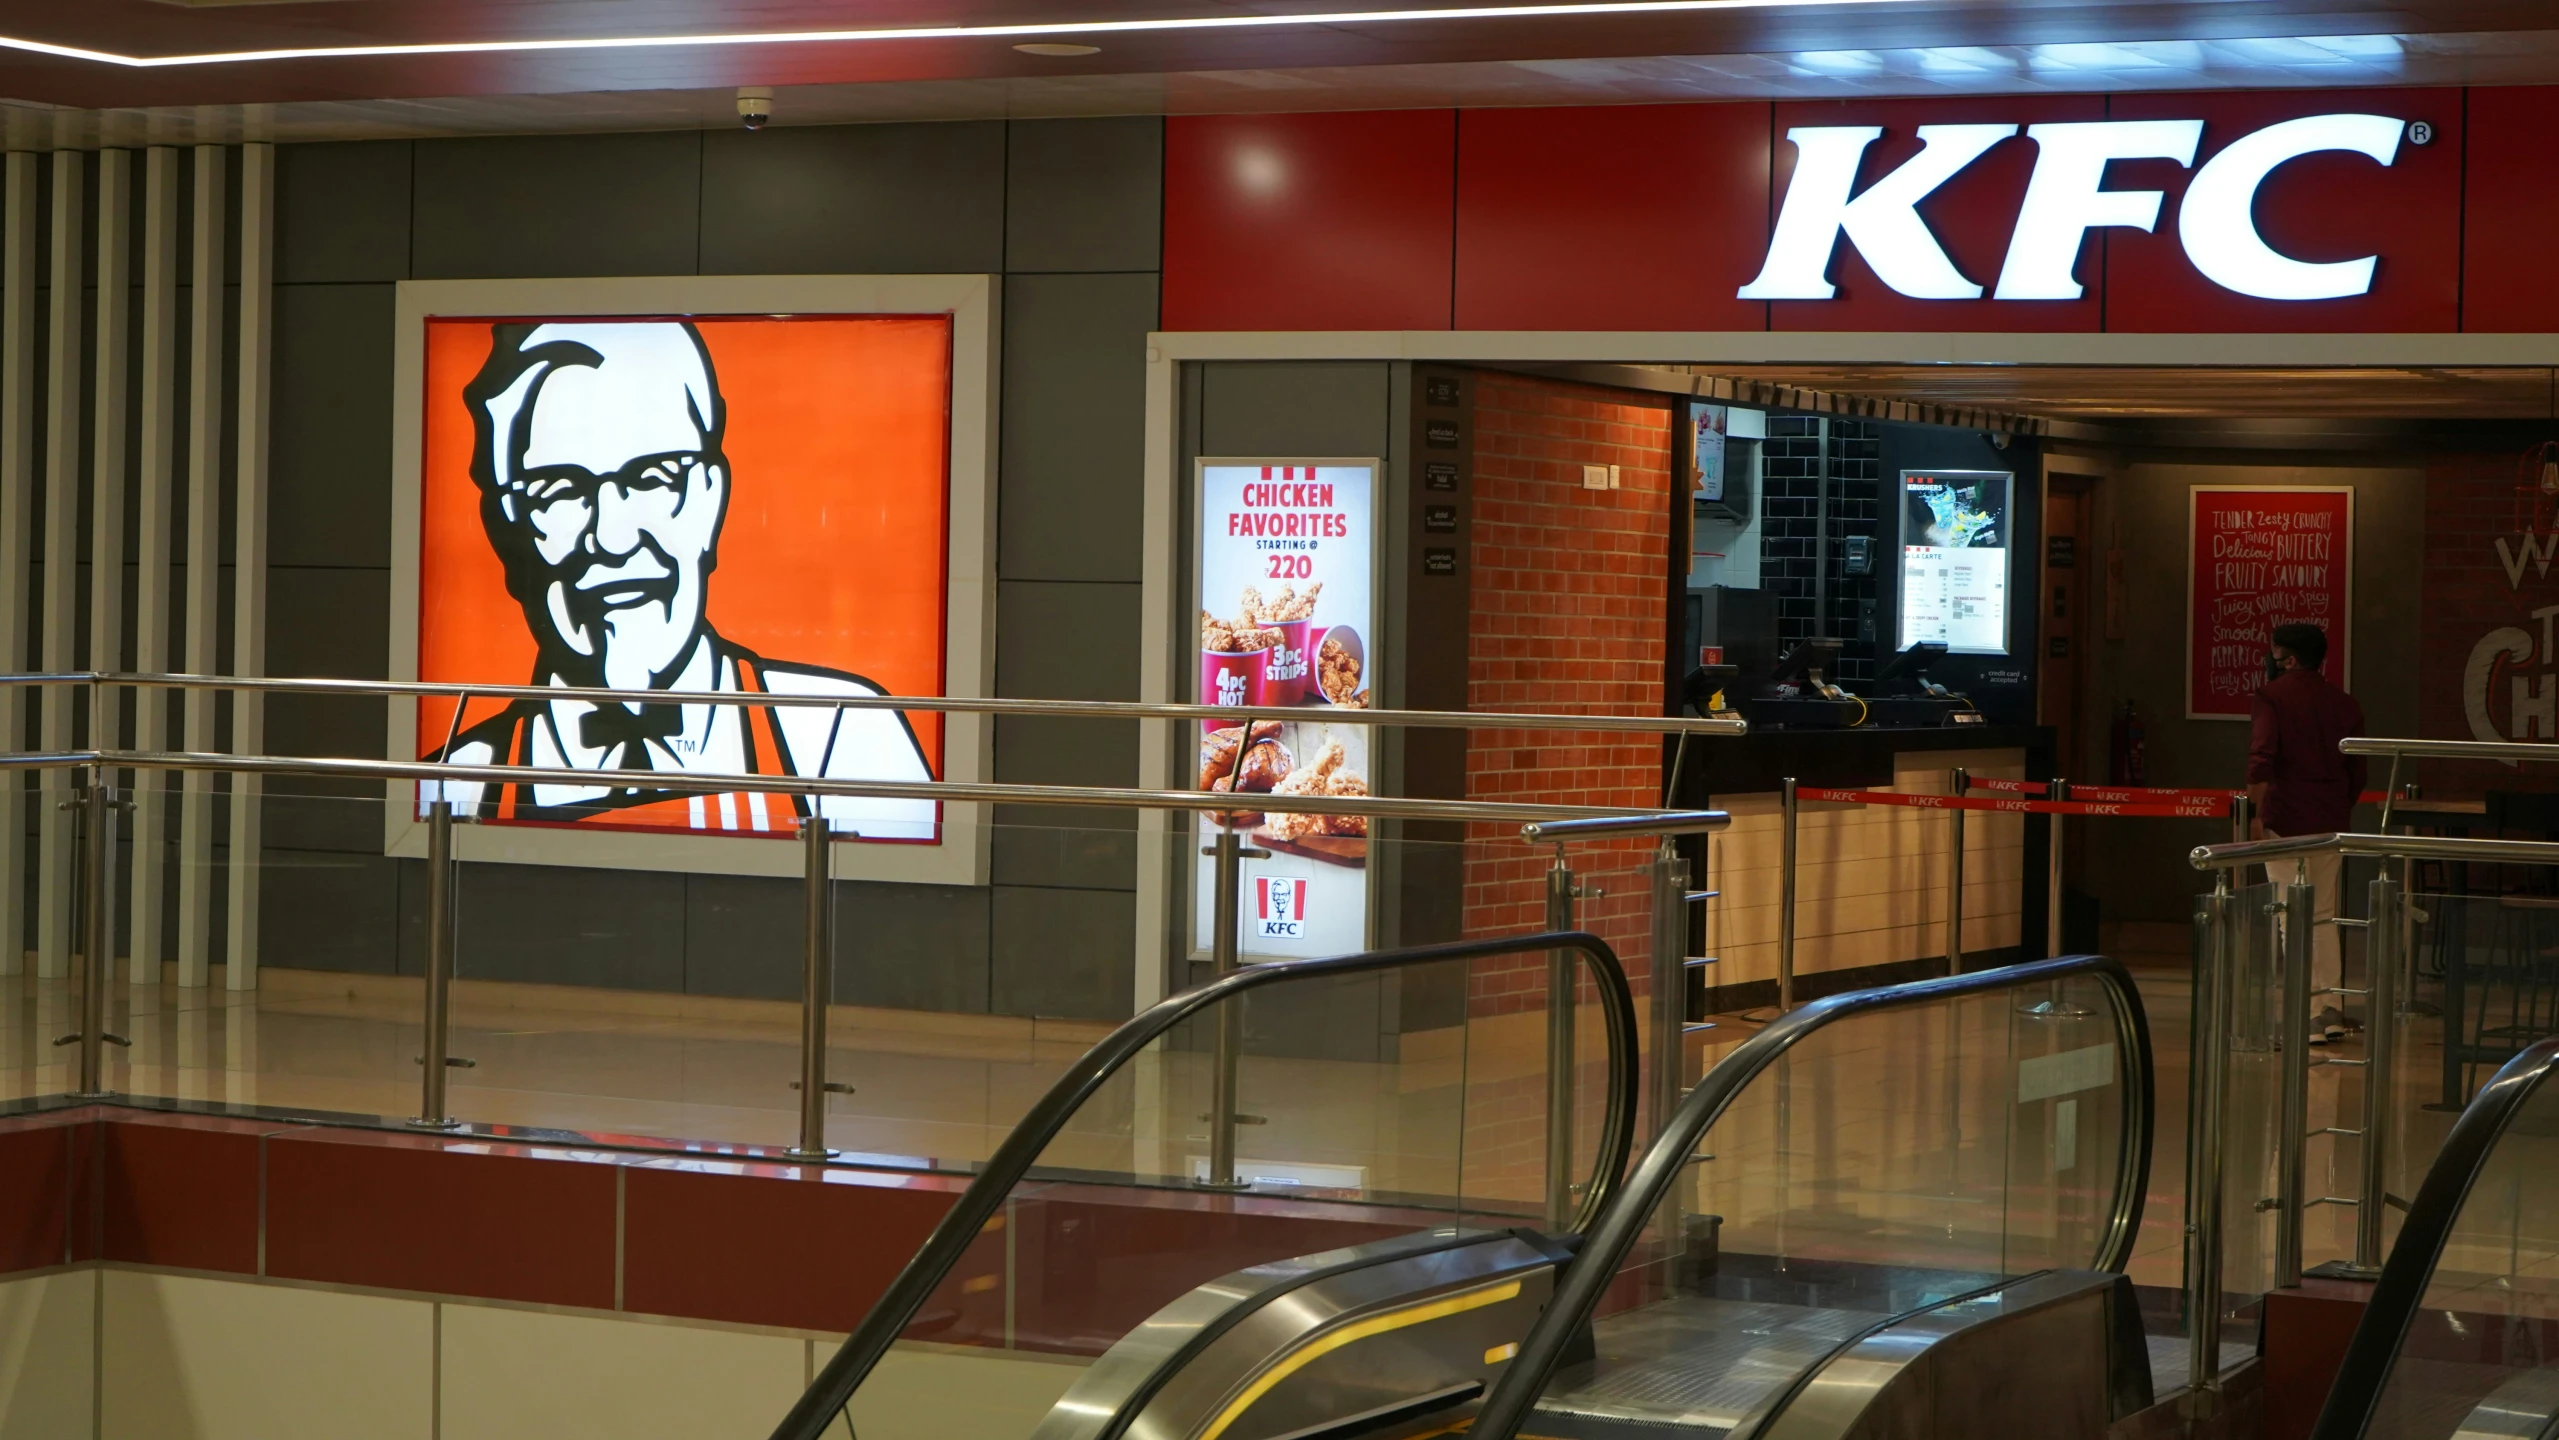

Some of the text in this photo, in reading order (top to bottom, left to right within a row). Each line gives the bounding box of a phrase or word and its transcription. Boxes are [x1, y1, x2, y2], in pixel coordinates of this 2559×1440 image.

[1736, 113, 2406, 301] KFC
[1243, 483, 1333, 507] CHICKEN
[1906, 483, 1943, 491] KRUSHERS
[1228, 513, 1347, 537] FAVORITES
[2212, 510, 2332, 532] TENDER Zesty CRUNCHY
[1256, 540, 1318, 550] STARTING @
[2213, 532, 2332, 562] Delicious BUTTERY
[2215, 561, 2329, 591] FRUITY SAVOURY
[2211, 590, 2329, 625] Juicy SMOKEY Spicy
[2213, 622, 2268, 643] Smooth
[1273, 644, 1302, 667] 3PC
[2211, 645, 2250, 669] PEPPERY
[1216, 667, 1246, 692] 4PC
[1266, 660, 1308, 681] STRIPS
[2209, 670, 2240, 696] fruity
[1218, 690, 1245, 706] HOT
[675, 740, 695, 752] TM
[1996, 781, 2020, 791] KFC
[1831, 791, 1856, 802] KFC
[1919, 796, 1943, 807] KFC
[2107, 792, 2130, 802] KFC
[2192, 796, 2216, 806] KFC
[2004, 801, 2031, 811] KFC
[2094, 805, 2120, 815] KFC
[2185, 806, 2210, 816] KFC
[1265, 922, 1297, 935] KFC
